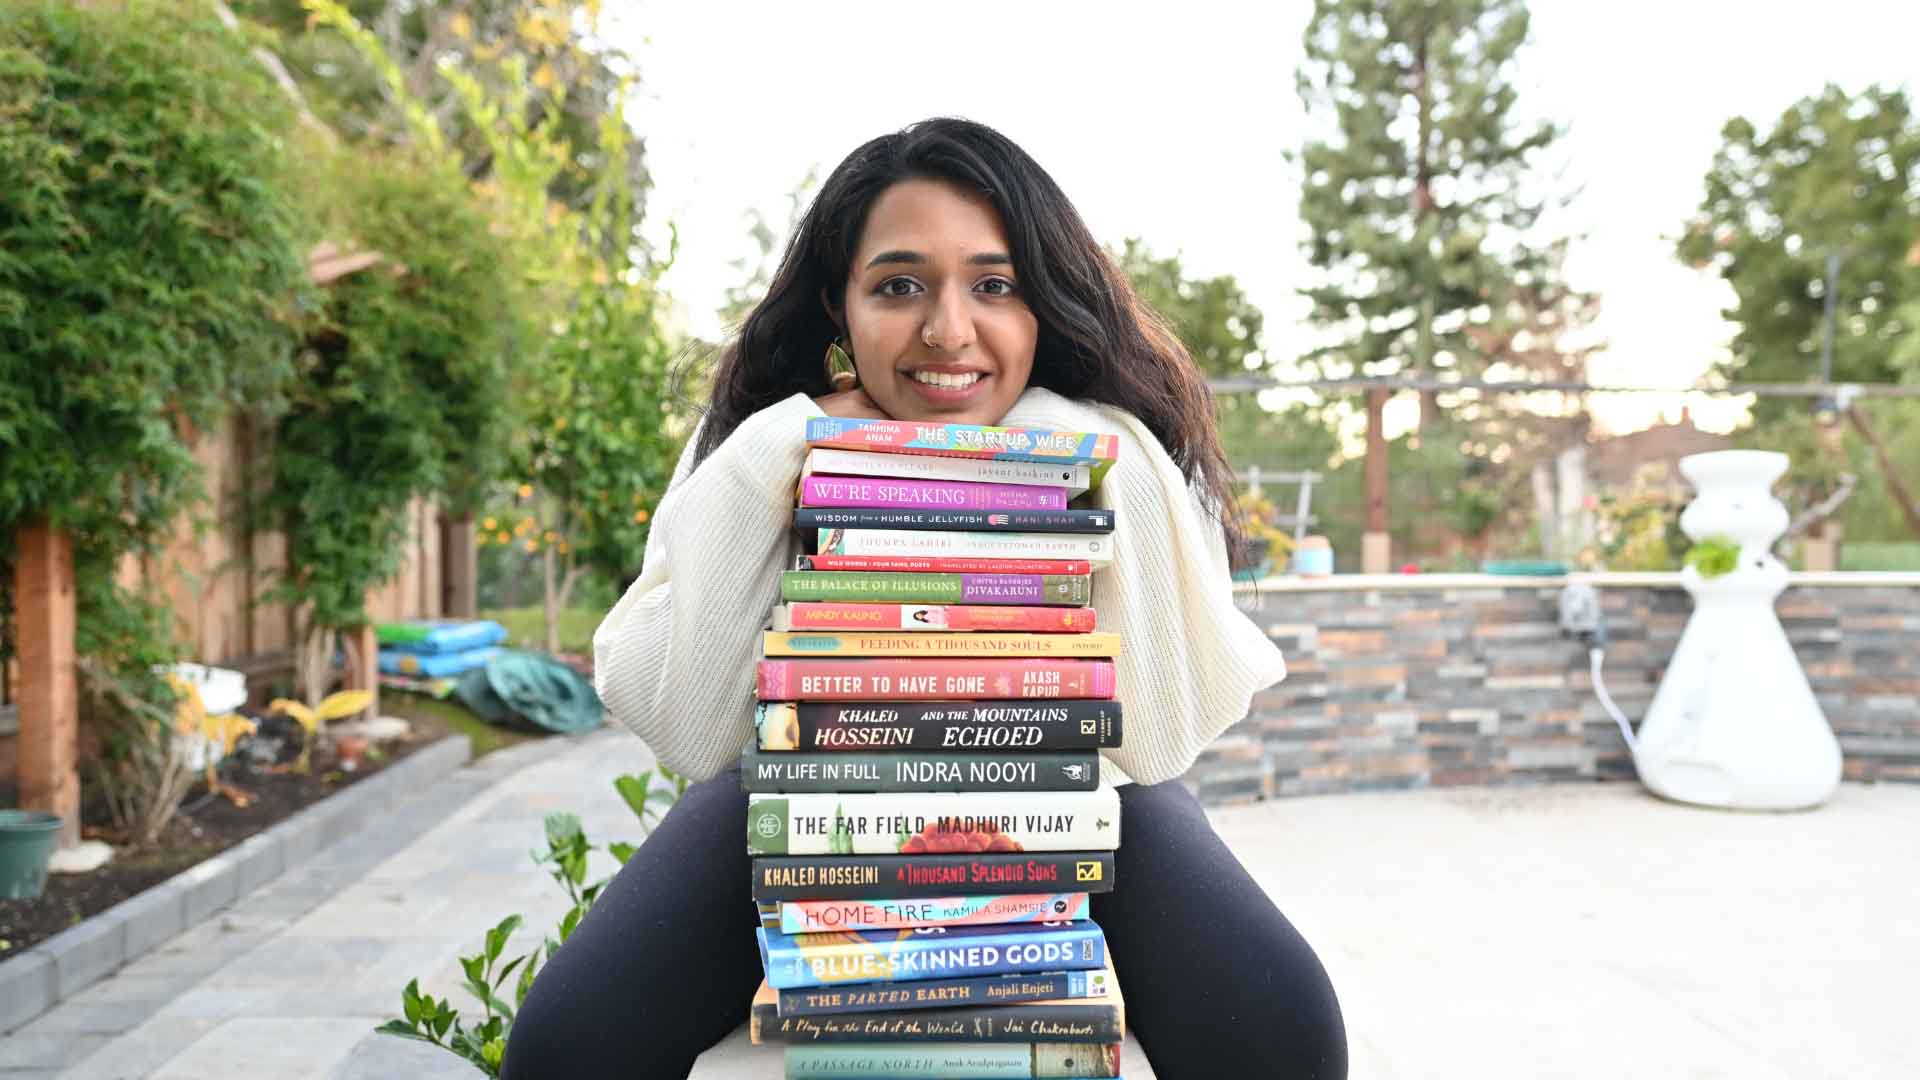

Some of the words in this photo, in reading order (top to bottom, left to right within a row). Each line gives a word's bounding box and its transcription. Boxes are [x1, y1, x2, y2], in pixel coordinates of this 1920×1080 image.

[858, 423, 900, 433] TAHMIMA
[865, 434, 892, 442] ANAM
[915, 427, 945, 441] THE
[955, 430, 1027, 447] STARTUP
[1036, 436, 1075, 449] WIFE
[813, 483, 872, 500] WE'RE
[878, 486, 966, 505] SPEAKING
[815, 514, 857, 522] WISDOM
[928, 515, 983, 523] JELLYFISH
[1015, 516, 1043, 525] HANI
[1046, 517, 1075, 525] SHAH
[791, 580, 820, 590] THE
[822, 580, 870, 591] PALACE
[871, 580, 887, 591] OF
[892, 580, 957, 591] ILLUSIONS
[966, 586, 1038, 597] DIVAKARUNI
[804, 610, 840, 620] MINDY
[861, 639, 919, 649] FEEDING
[934, 640, 1007, 650] THOUSAND
[1009, 640, 1051, 650] SOULS
[802, 676, 862, 693] BETTER
[872, 676, 891, 693] TO
[899, 676, 937, 693] HAVE
[946, 676, 985, 693] GONE
[1023, 671, 1060, 684] AKASH
[1023, 686, 1060, 697] KAPUR
[838, 710, 899, 723] KHALED
[921, 711, 944, 721] AND
[947, 711, 968, 721] THE
[972, 708, 1068, 722] MOUNTAINS
[815, 727, 914, 747] HOSSEINI
[942, 726, 1043, 747] ECHOED
[758, 764, 782, 779] MY
[787, 764, 817, 779] LIFE
[824, 764, 839, 779] IN
[844, 764, 881, 780] FULL
[896, 762, 962, 783] INDRA
[970, 762, 1035, 782] NOOYI
[794, 816, 827, 835] THE
[837, 816, 867, 834] FAR
[876, 816, 925, 834] FIELD
[937, 815, 1017, 833] MADHURI
[1026, 814, 1074, 833] VIJAY
[764, 867, 815, 886] KHALED
[819, 865, 878, 885] HOSSEINI
[907, 864, 966, 884] THOUSAND
[971, 862, 1024, 883] SPLENDID
[1027, 861, 1057, 881] SUNS
[806, 905, 874, 926] HOME
[884, 904, 933, 922] FIRE
[943, 905, 992, 917] KAMILA
[995, 902, 1047, 914] SHAMSIE
[811, 946, 999, 977] BLUE-SKINNED
[1006, 942, 1074, 964] GODS
[807, 995, 841, 1007] THE
[848, 991, 910, 1006] PARTED
[916, 986, 971, 1000] EARTH
[987, 982, 1019, 998] Anjali
[1020, 981, 1054, 996] Enjeti
[781, 1019, 790, 1032] A
[796, 1019, 820, 1039] Play
[864, 1020, 888, 1033] End
[890, 1020, 904, 1032] of
[927, 1021, 965, 1034] World
[1003, 1019, 1024, 1033] Jai
[1030, 1020, 1094, 1035] Chakrabarti
[812, 1059, 874, 1071] PASSAGE
[881, 1059, 934, 1071] NORTH
